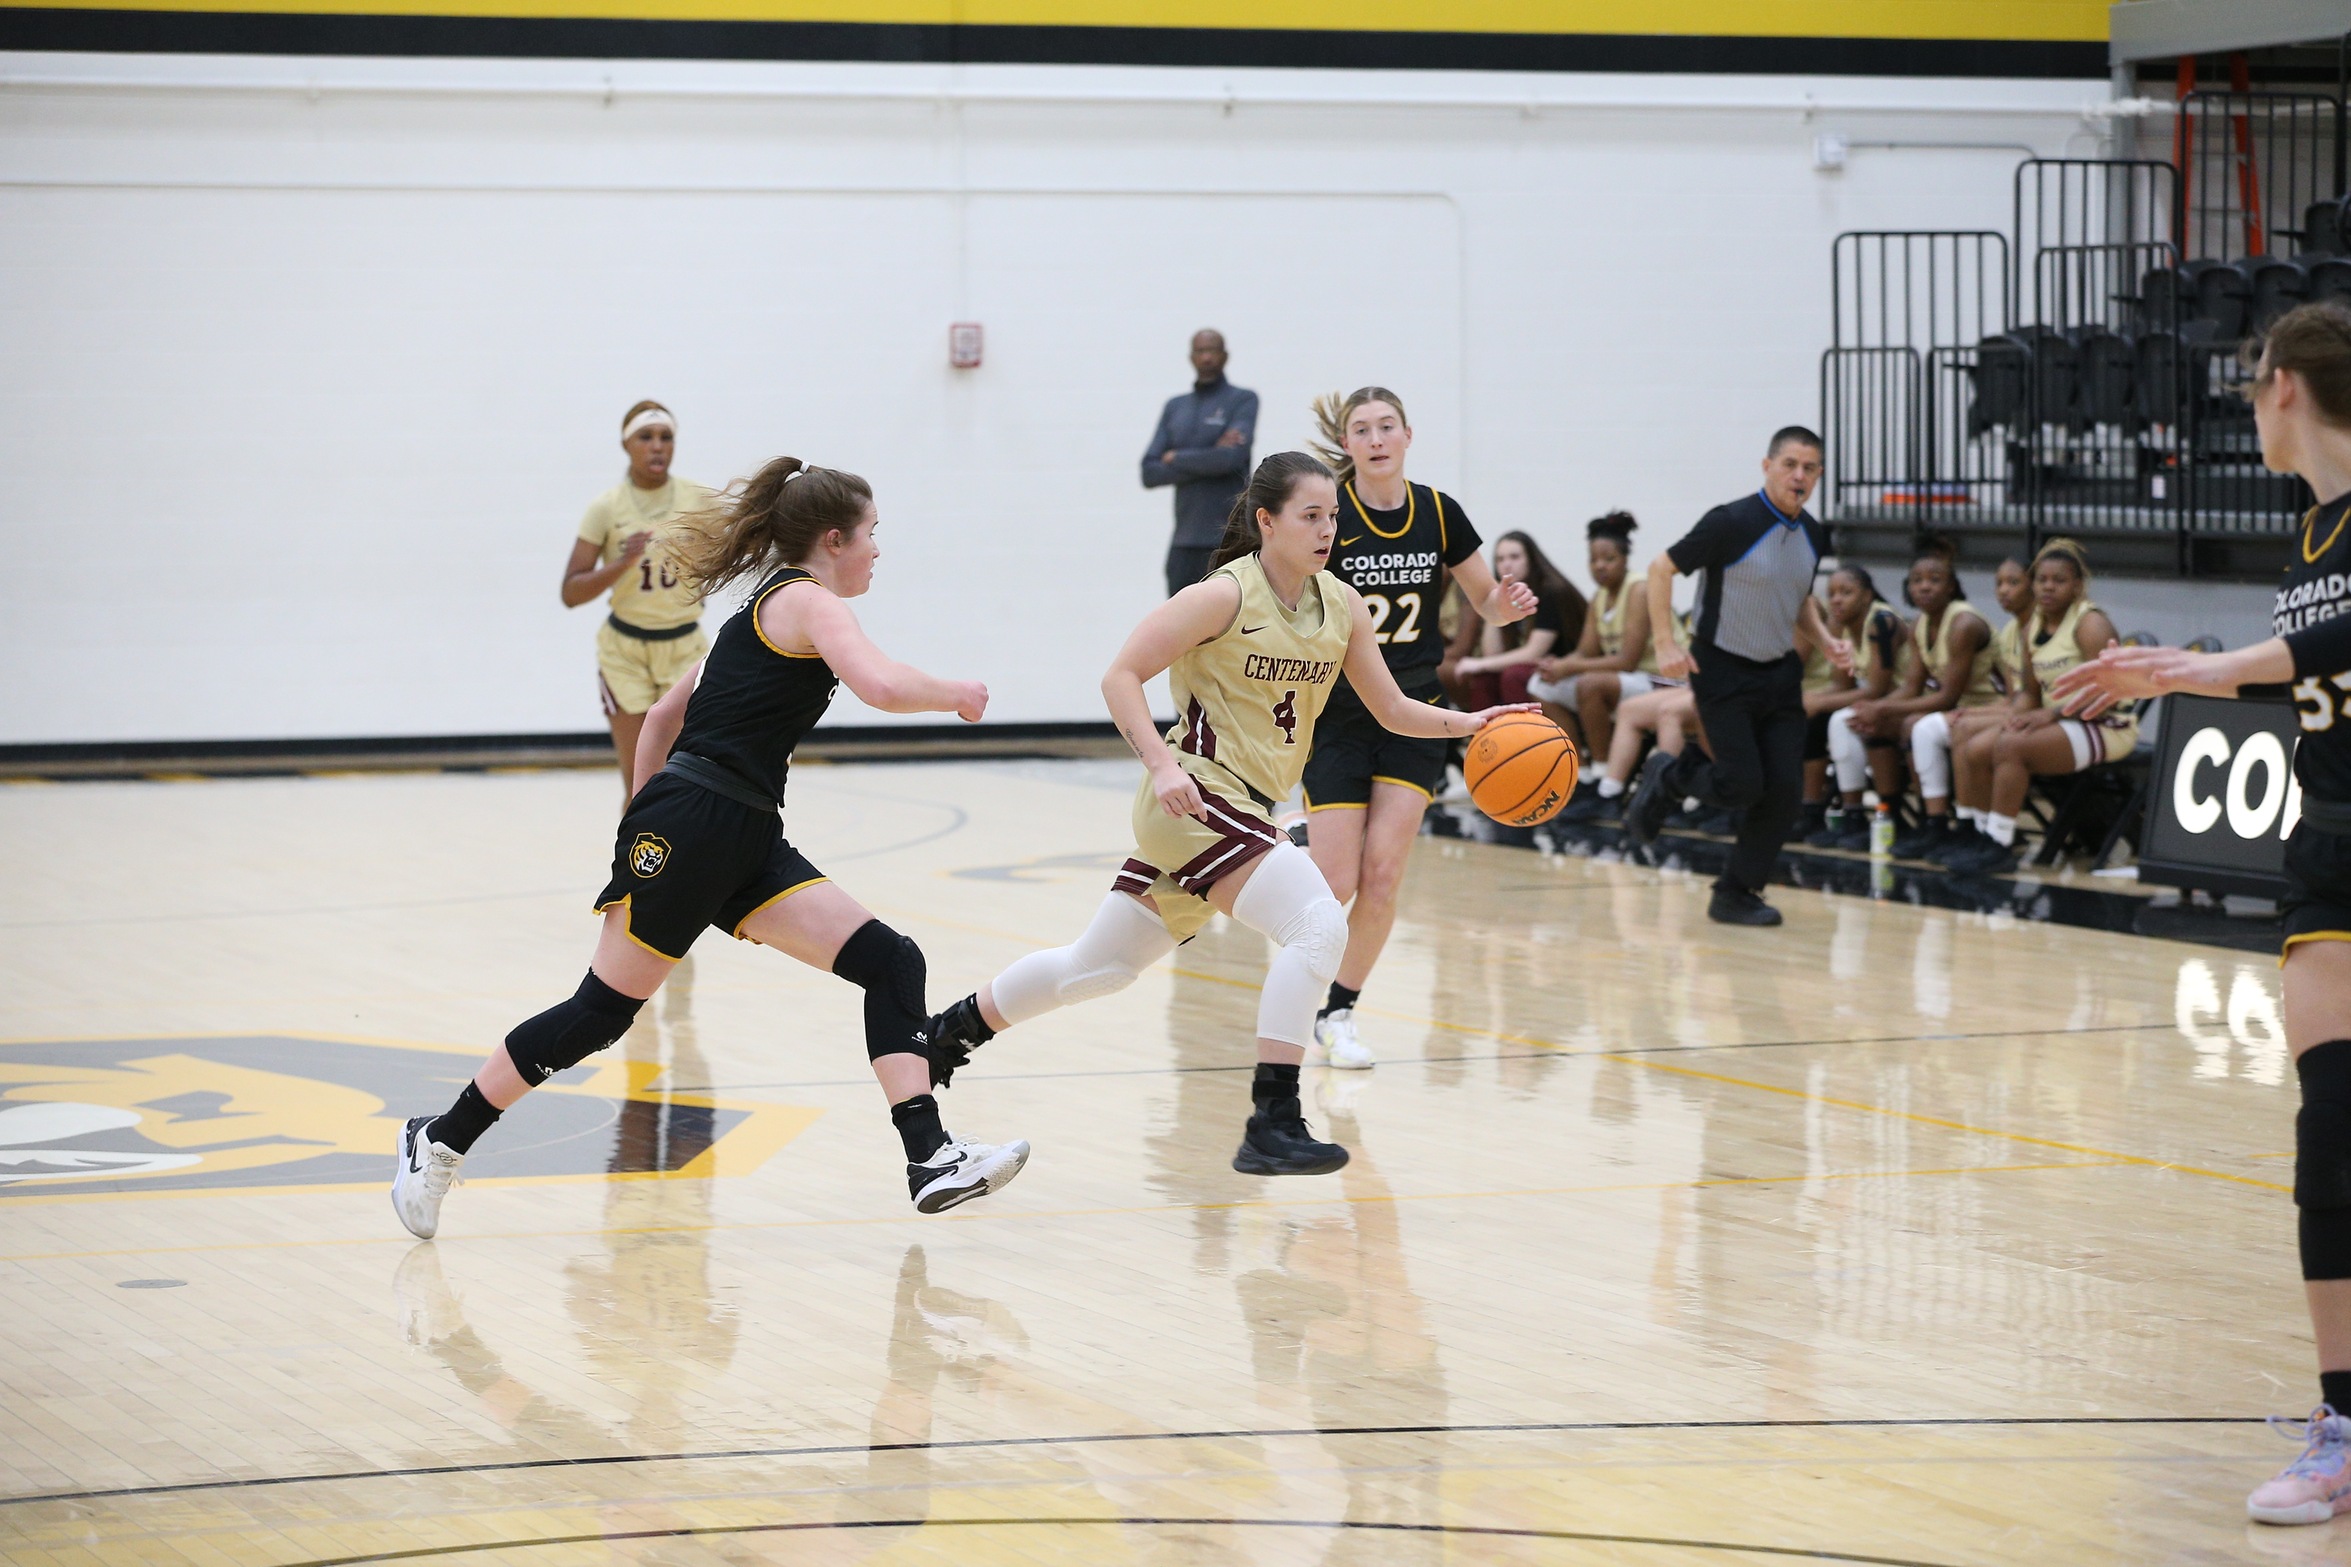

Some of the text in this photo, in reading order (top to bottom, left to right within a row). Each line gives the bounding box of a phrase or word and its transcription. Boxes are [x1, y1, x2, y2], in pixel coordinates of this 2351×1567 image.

[1341, 552, 1438, 571] COLORADO
[1352, 569, 1431, 587] COLLEGE
[1362, 592, 1421, 644] 22
[1244, 653, 1337, 684] CENTENARY
[1272, 689, 1298, 745] 4
[2173, 726, 2303, 841] CO
